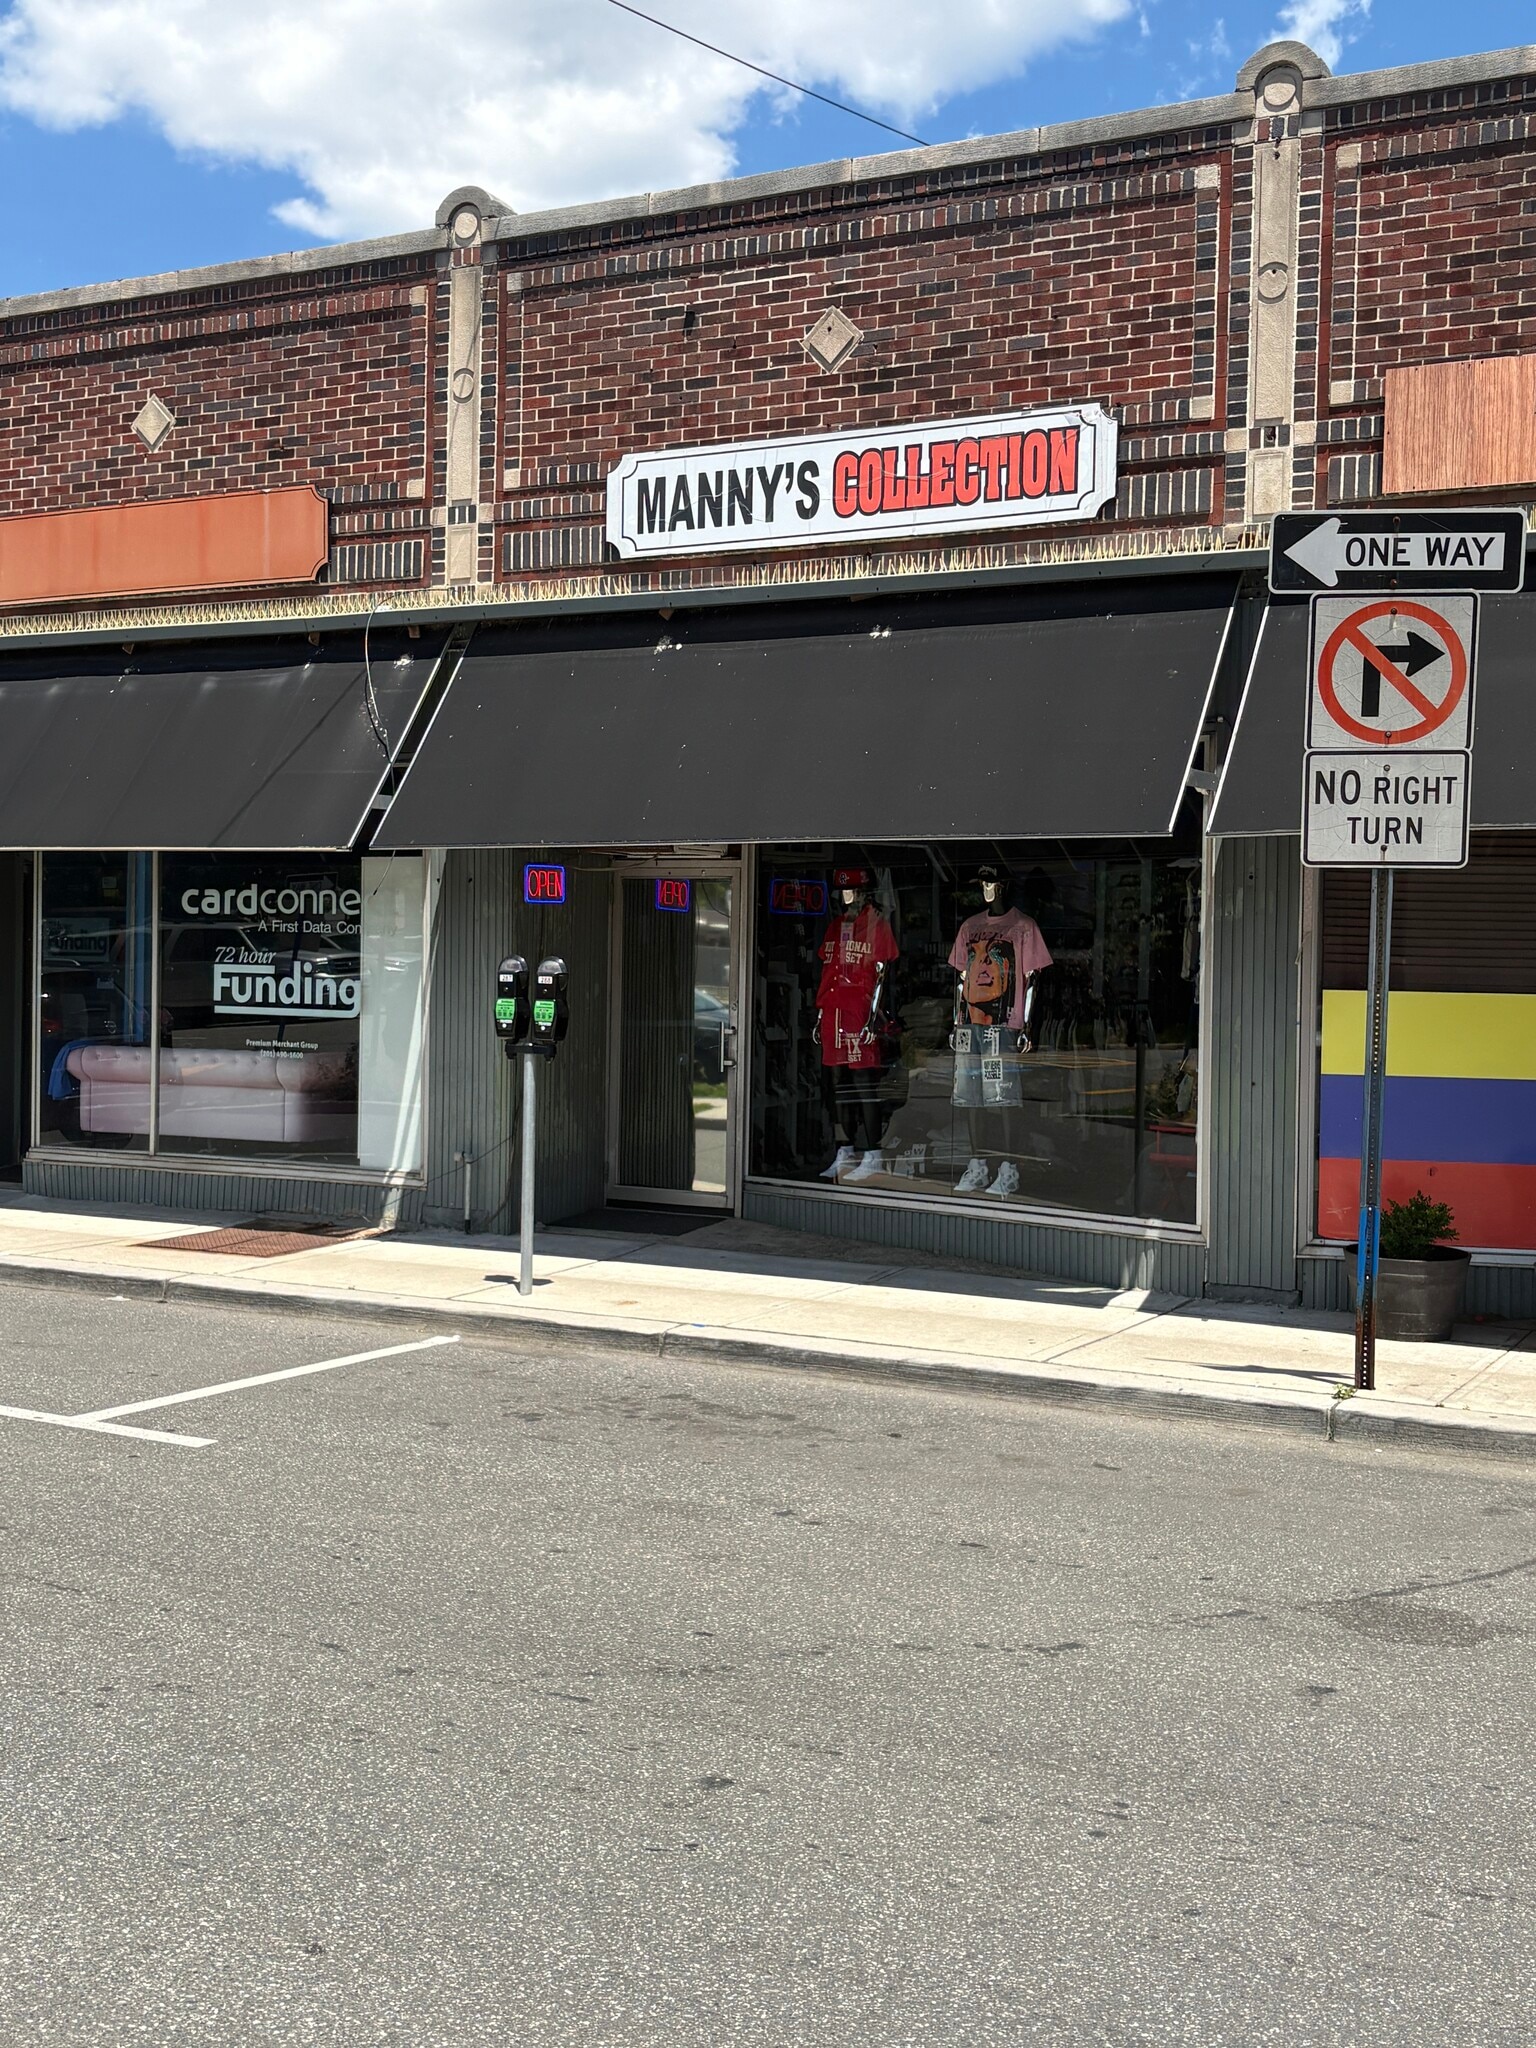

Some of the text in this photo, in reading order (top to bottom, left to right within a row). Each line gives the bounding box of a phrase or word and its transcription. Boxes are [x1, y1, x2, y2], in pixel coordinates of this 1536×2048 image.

[637, 424, 1080, 534] MANNY'S COLLECTION
[1345, 537, 1495, 567] ONE WAY
[1314, 770, 1457, 805] NO RIGHT
[1347, 816, 1423, 844] TURN
[528, 870, 562, 897] OPEN
[258, 922, 267, 932] A
[272, 920, 298, 933] First
[303, 921, 332, 933] Data
[215, 946, 276, 964] 72 hour
[213, 961, 361, 1018] Funding
[246, 1039, 318, 1050] Premium Merchant Group
